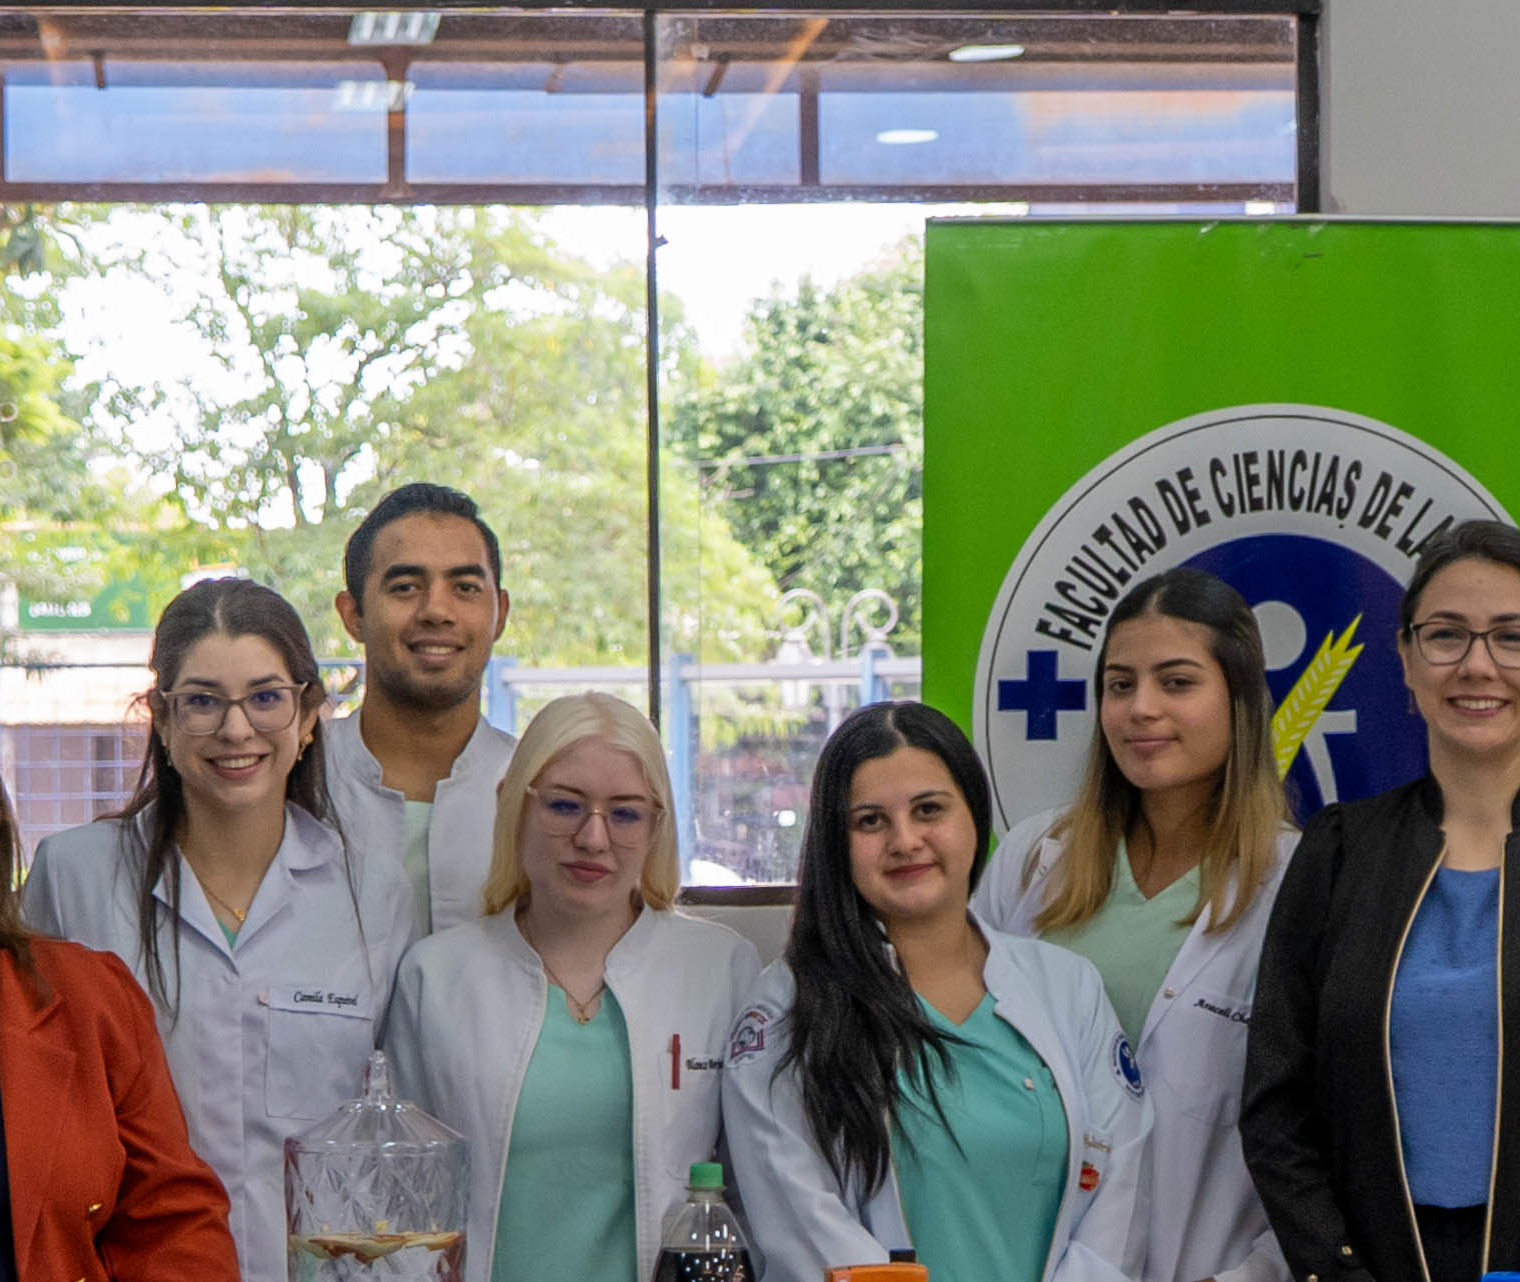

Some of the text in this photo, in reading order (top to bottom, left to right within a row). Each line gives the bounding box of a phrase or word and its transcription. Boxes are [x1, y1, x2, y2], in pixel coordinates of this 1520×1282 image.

[1035, 496, 1167, 651] FACULTAD
[1155, 466, 1212, 536] DE
[1209, 449, 1362, 520] CIENCIAS
[1357, 471, 1416, 540] DE
